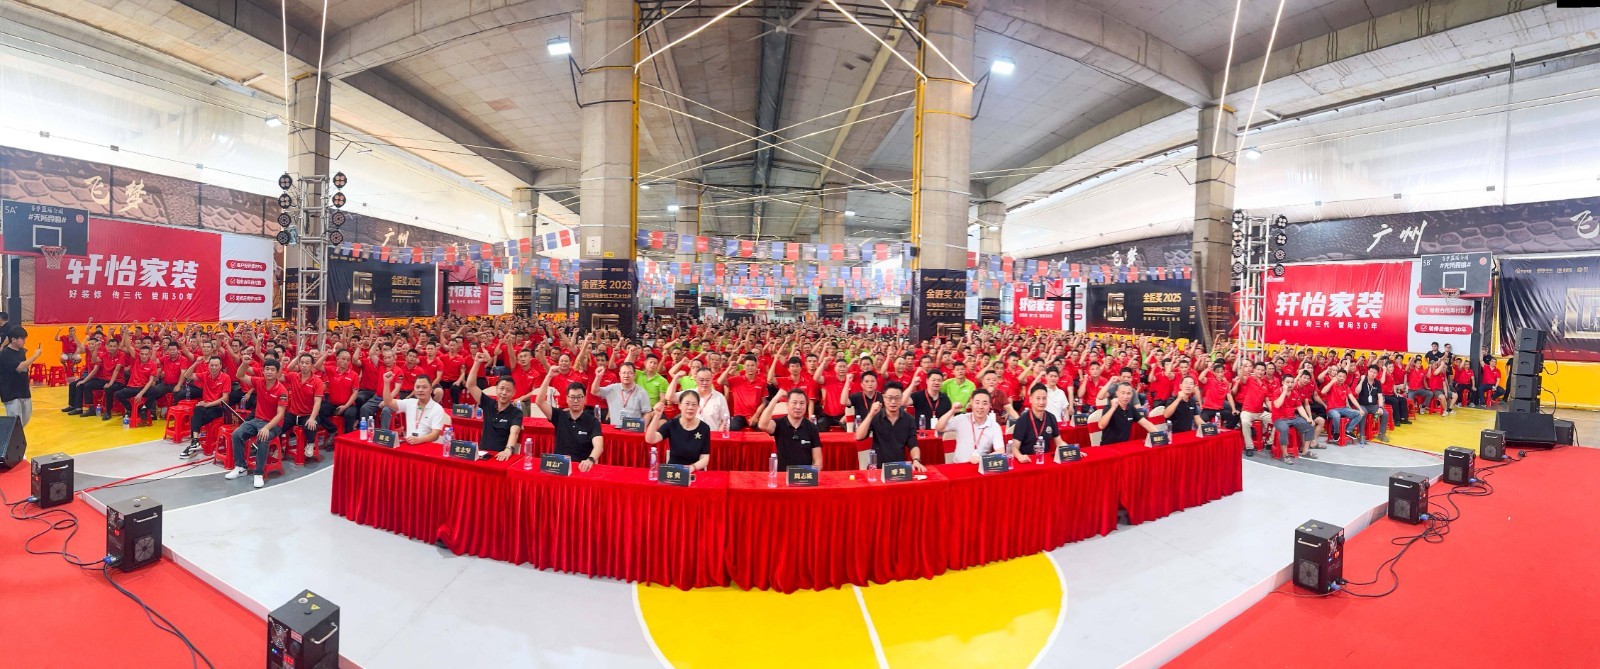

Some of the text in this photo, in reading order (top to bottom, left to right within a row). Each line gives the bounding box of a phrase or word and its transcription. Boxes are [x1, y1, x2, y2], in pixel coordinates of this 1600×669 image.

[1570, 210, 1599, 239] 飞
[1367, 220, 1427, 254] 广州
[66, 254, 199, 289] 轩怡家装
[581, 280, 632, 289] 金匠奖 2025
[69, 290, 193, 300] 好装修 传三代 管用30年
[926, 289, 952, 299] 金匠奖
[1143, 293, 1182, 303] 金匠奖 2025
[1275, 292, 1384, 318] 轩怡家装
[1306, 320, 1330, 328] 传三代
[1338, 321, 1378, 330] 管用30年
